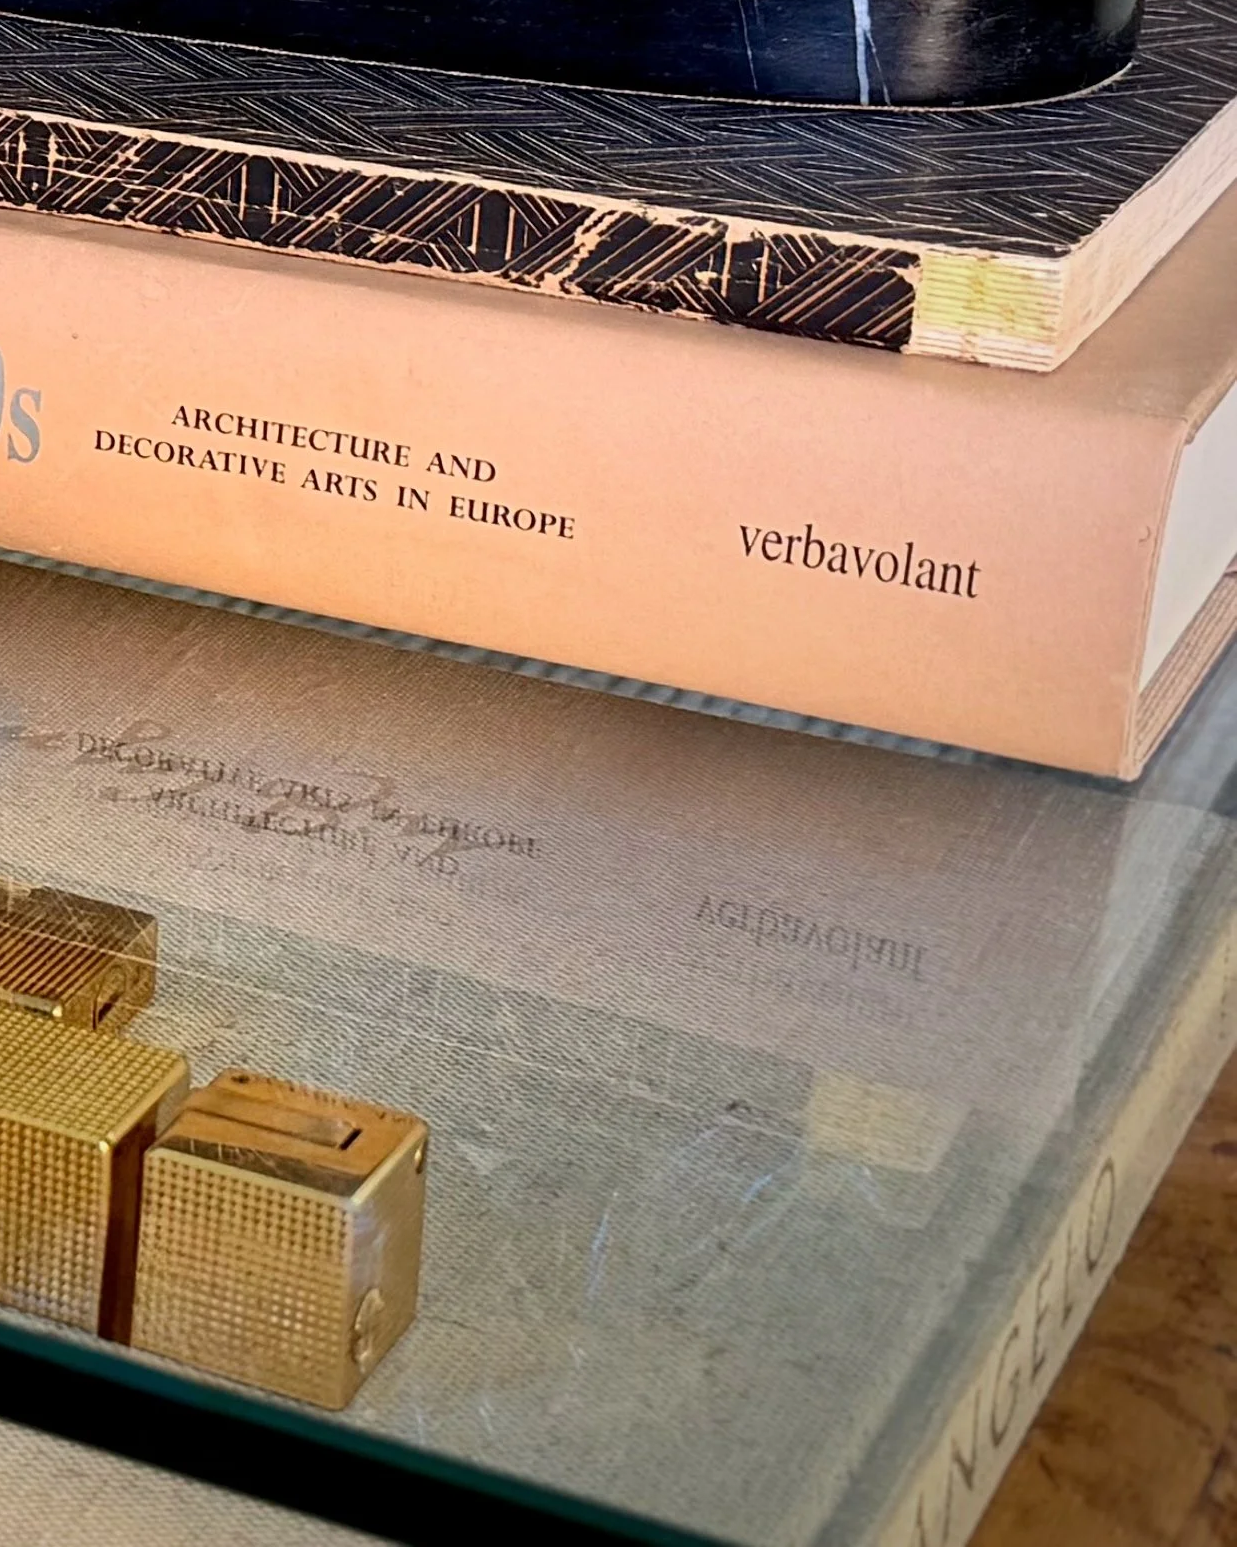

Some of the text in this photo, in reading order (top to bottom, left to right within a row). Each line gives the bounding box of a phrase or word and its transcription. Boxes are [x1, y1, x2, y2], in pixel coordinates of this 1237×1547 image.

[171, 404, 497, 483] ARCHITECTURE AND
[94, 430, 576, 540] DECORATIVE ARTS IN EUROPE
[739, 523, 981, 599] verbavolant
